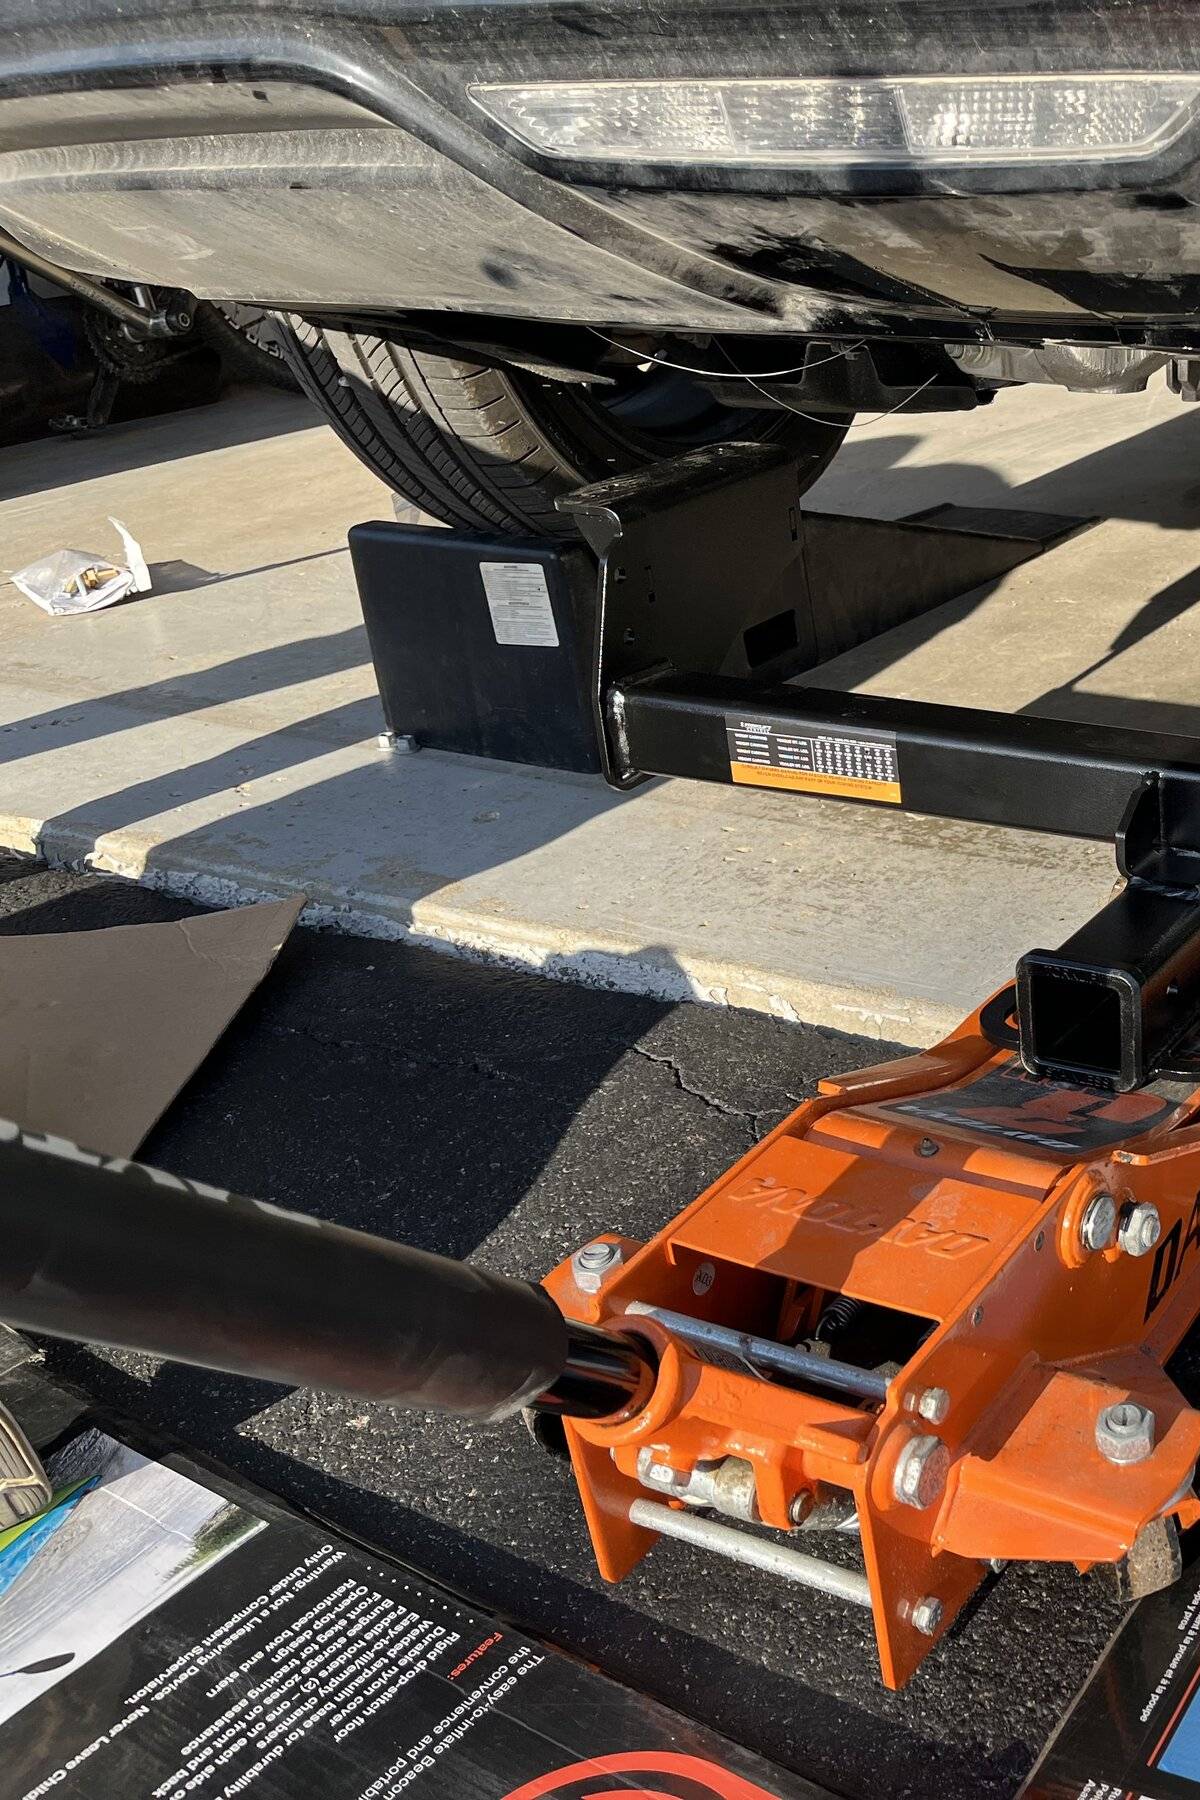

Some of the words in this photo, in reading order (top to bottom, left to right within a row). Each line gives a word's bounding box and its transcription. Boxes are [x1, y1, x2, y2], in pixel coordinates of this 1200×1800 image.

[304, 1544, 333, 1566] Only
[268, 1566, 305, 1595] Under
[291, 1551, 346, 1591] Warning:
[259, 1608, 270, 1616] a
[268, 1591, 294, 1610] Not
[290, 1578, 356, 1631] Reinforced
[312, 1585, 368, 1629] Open-top
[345, 1591, 381, 1619] Front
[201, 1595, 268, 1646] Competent
[315, 1618, 347, 1643] skeg
[346, 1598, 394, 1636] Bungee
[363, 1605, 406, 1640] Paddle
[1177, 1610, 1192, 1629] proa
[196, 1616, 262, 1665] Lifesaving
[264, 1629, 293, 1651] bow
[270, 1629, 312, 1662] design
[299, 1642, 319, 1658] for
[386, 1620, 433, 1658] Welded
[397, 1625, 446, 1666] Durable
[426, 1631, 460, 1660] Rigid
[238, 1650, 264, 1672] and
[300, 1636, 347, 1674] storage
[317, 1612, 419, 1697] Easy-to-fill/empty
[318, 1639, 366, 1677] holders
[446, 1631, 502, 1680] Features:
[508, 1646, 530, 1664] the
[516, 1655, 545, 1675] The
[1169, 1643, 1186, 1668] proue
[124, 1645, 203, 1704] Supervision.
[150, 1665, 199, 1700] Device.
[205, 1670, 239, 1697] stern
[246, 1658, 300, 1699] tracking
[262, 1673, 302, 1704] zones
[299, 1677, 319, 1692] (2)
[333, 1657, 388, 1701] tarpaulin
[362, 1665, 399, 1695] nylon
[362, 1659, 427, 1715] drop-stitch
[244, 1704, 263, 1720] on
[265, 1700, 290, 1721] one
[302, 1701, 336, 1728] base
[329, 1695, 363, 1726] cover
[432, 1665, 508, 1734] convenience
[1139, 1693, 1159, 1722] poupe
[108, 1704, 149, 1736] Never
[180, 1698, 248, 1755] assistance
[246, 1721, 265, 1737] on
[256, 1696, 317, 1748] chambers
[333, 1715, 364, 1742] floor
[433, 1676, 517, 1754] easy-to-inflate
[212, 1720, 246, 1747] front
[284, 1727, 304, 1745] for
[406, 1734, 432, 1759] and
[65, 1735, 110, 1769] Leave
[186, 1746, 213, 1770] and
[214, 1737, 247, 1764] each
[151, 1768, 189, 1797] back
[184, 1764, 215, 1789] side
[223, 1745, 283, 1797] durability
[358, 1756, 407, 1800] portabi
[382, 1754, 435, 1800] Beacon
